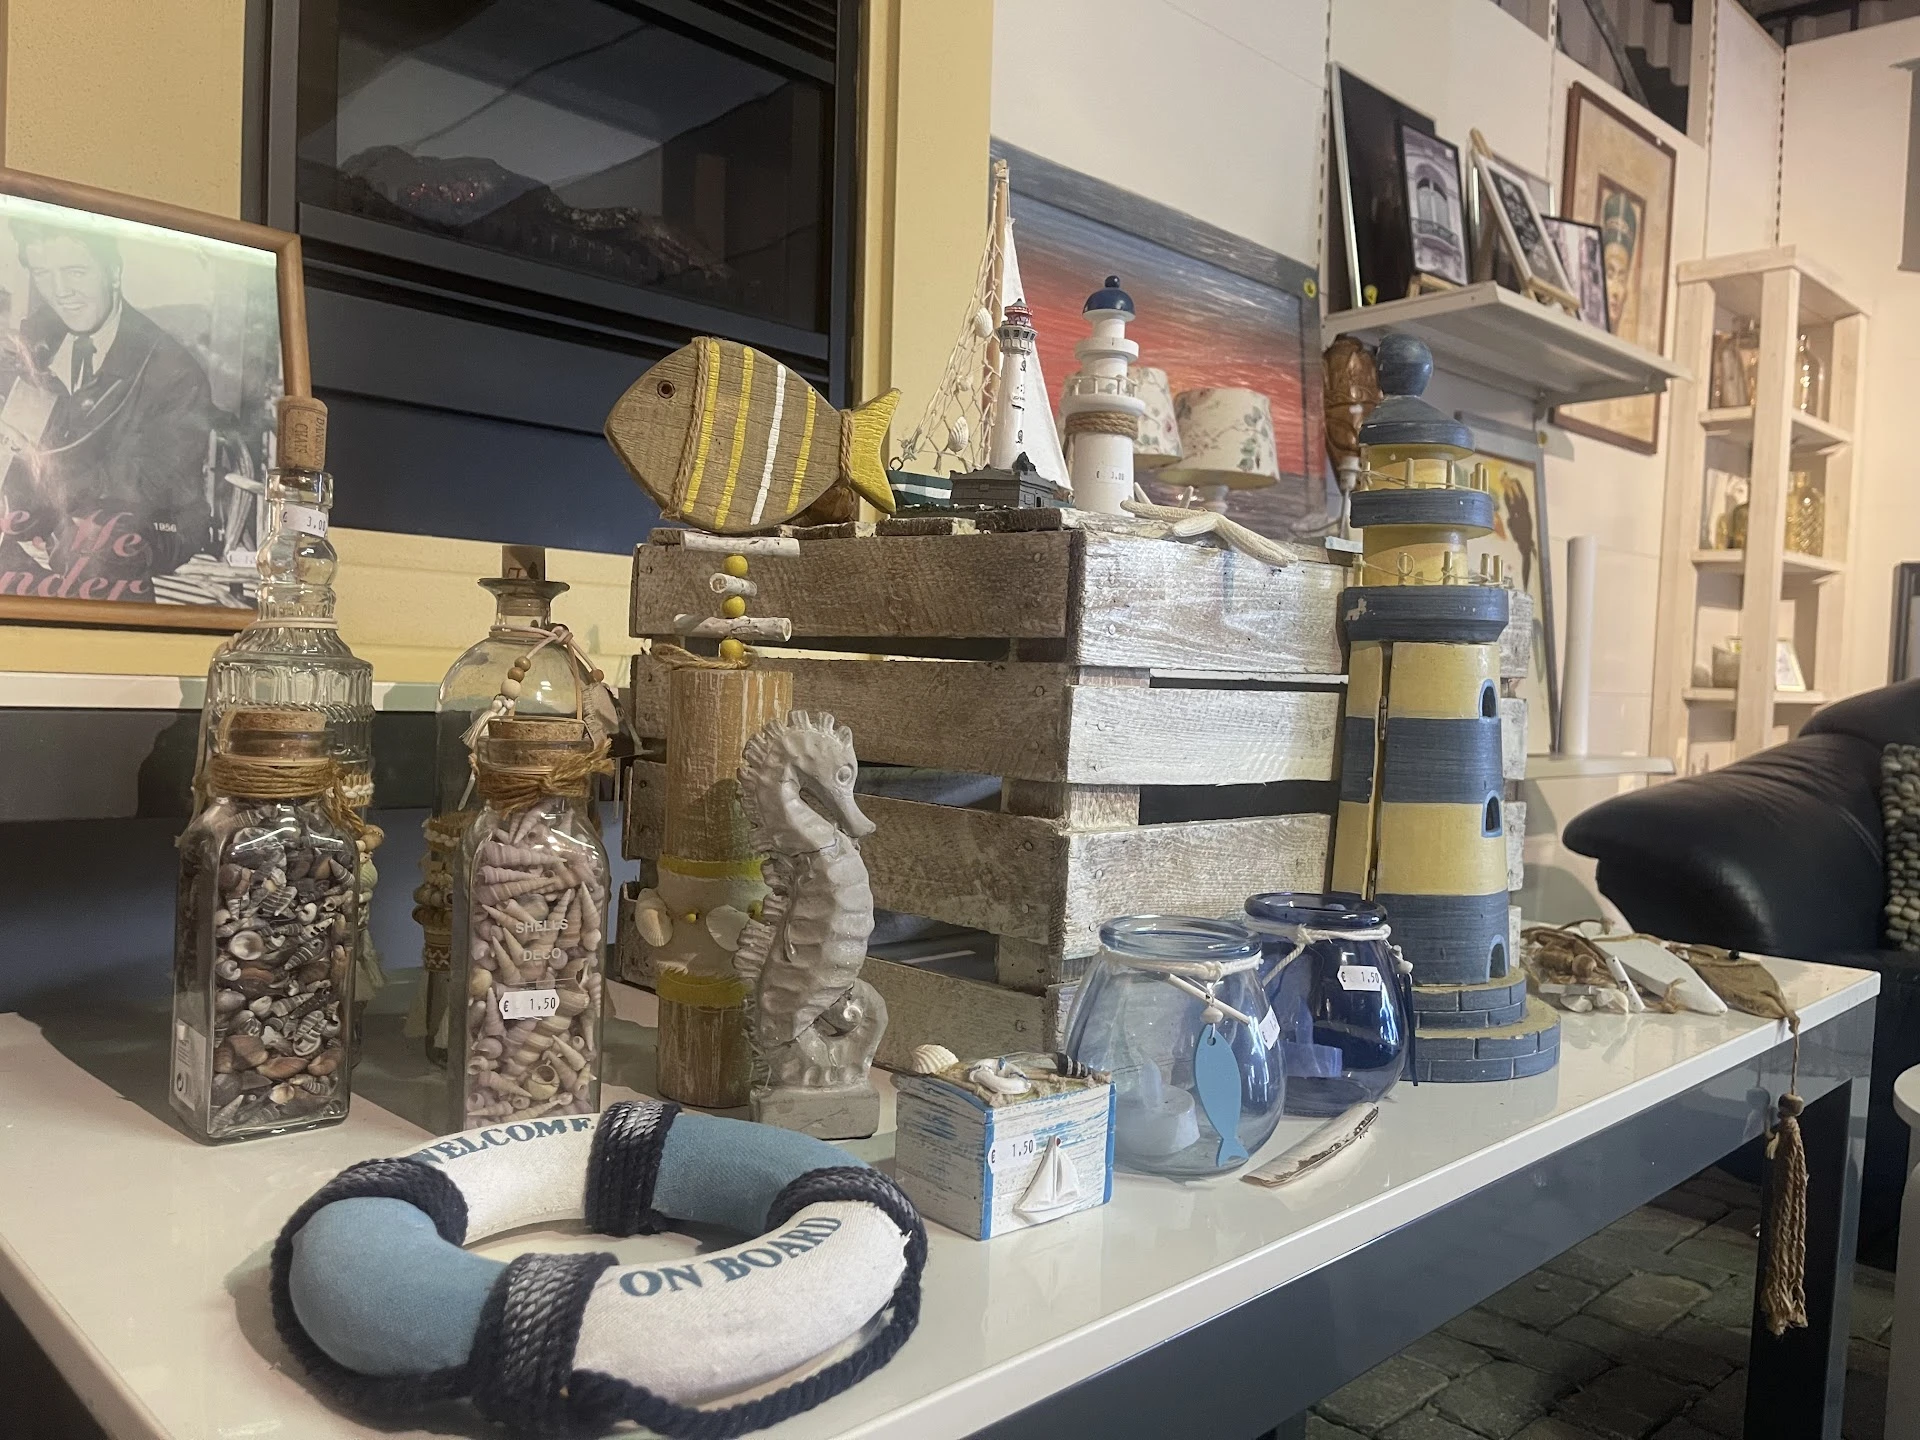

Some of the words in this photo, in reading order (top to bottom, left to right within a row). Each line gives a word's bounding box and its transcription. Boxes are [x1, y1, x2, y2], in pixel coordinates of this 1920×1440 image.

[153, 522, 177, 533] 1956
[515, 918, 569, 934] SHELLS
[523, 947, 562, 962] DECO
[619, 1264, 703, 1297] ON
[704, 1216, 842, 1283] BOARD
